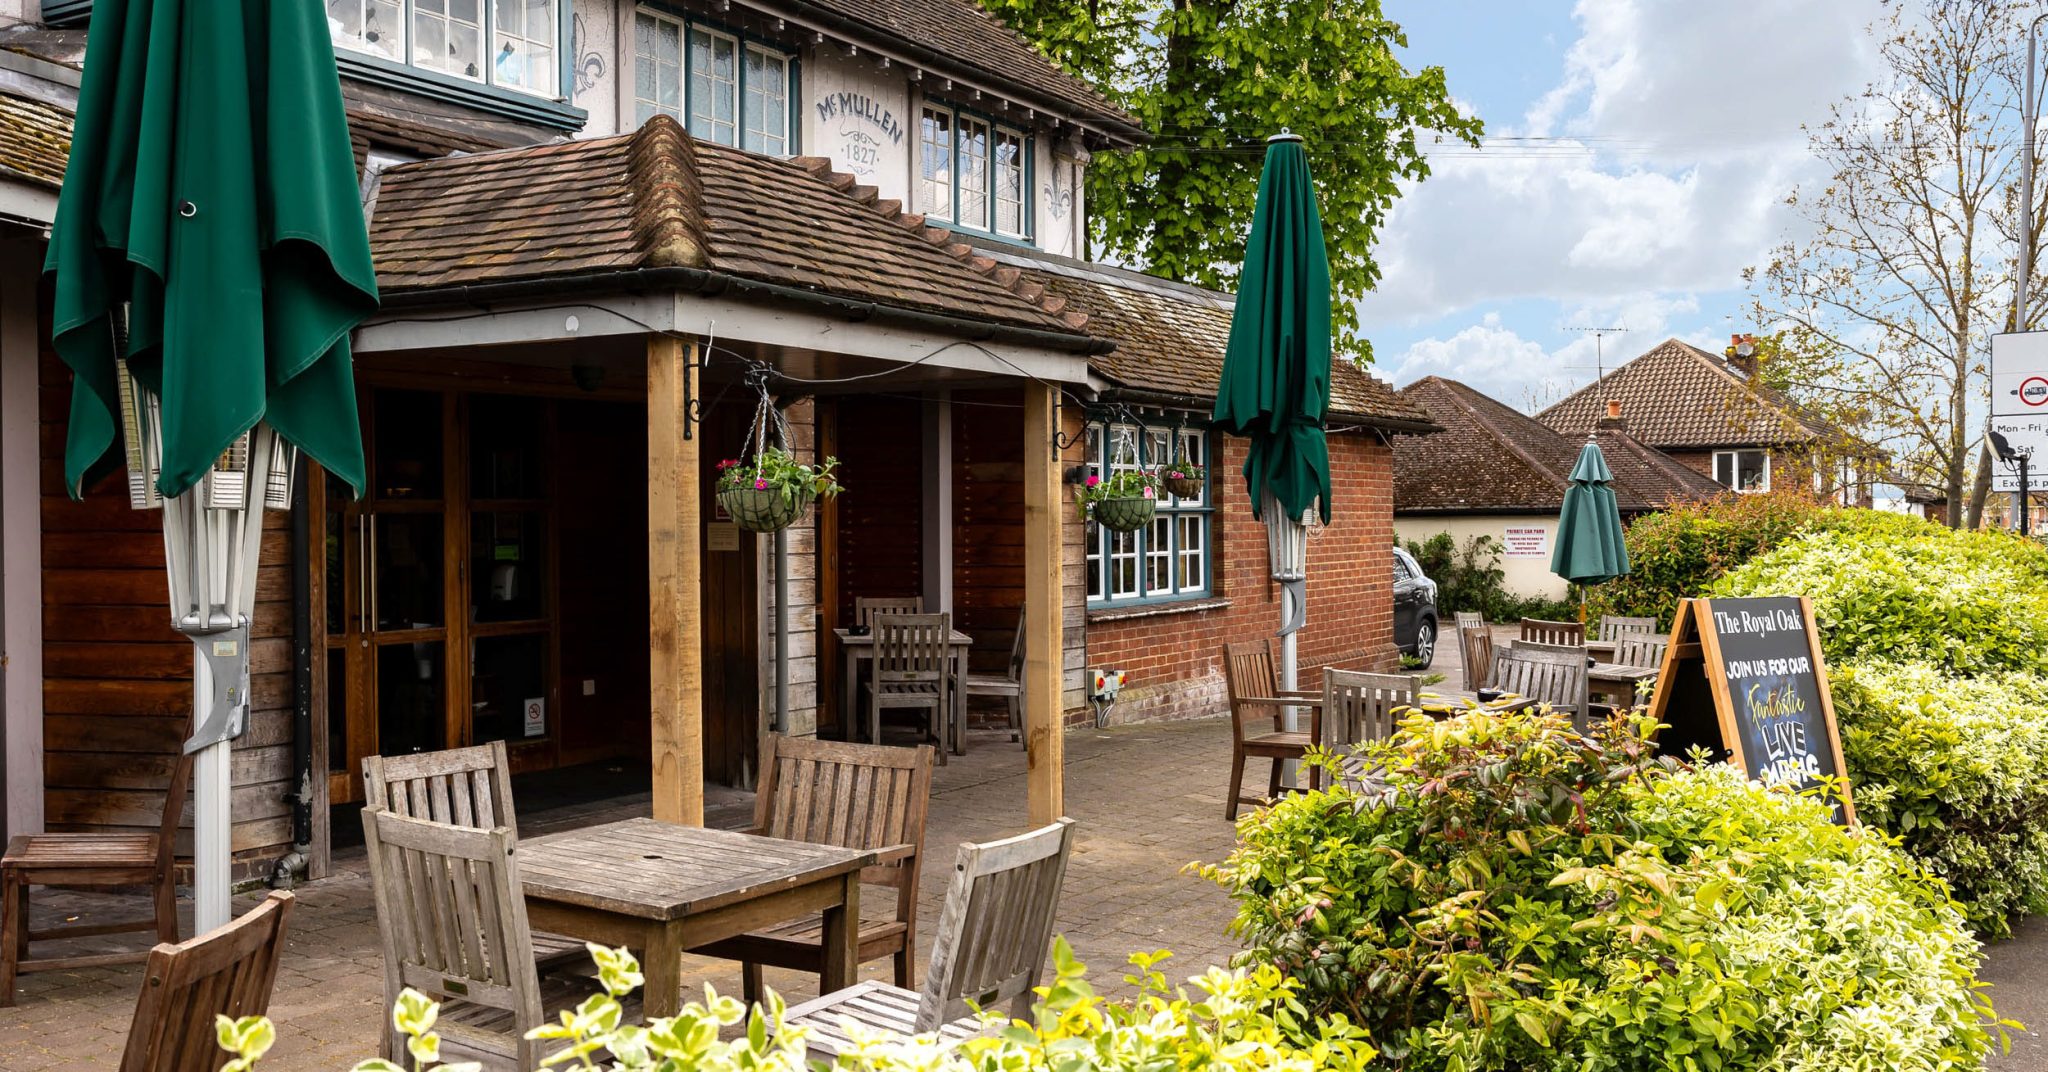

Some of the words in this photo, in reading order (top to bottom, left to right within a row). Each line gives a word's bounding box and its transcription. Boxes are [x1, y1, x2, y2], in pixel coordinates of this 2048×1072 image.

[2017, 445, 2034, 453] Sat
[2002, 479, 2038, 488] Excpt
[1714, 612, 1741, 633] The
[1740, 610, 1777, 638] Royal
[1777, 609, 1803, 631] Oak
[1726, 660, 1753, 679] JOIN
[1752, 660, 1768, 677] US
[1768, 658, 1789, 675] FOR
[1788, 657, 1810, 674] OUR
[1747, 683, 1805, 730] Fantastic
[1761, 720, 1807, 761] LIVE
